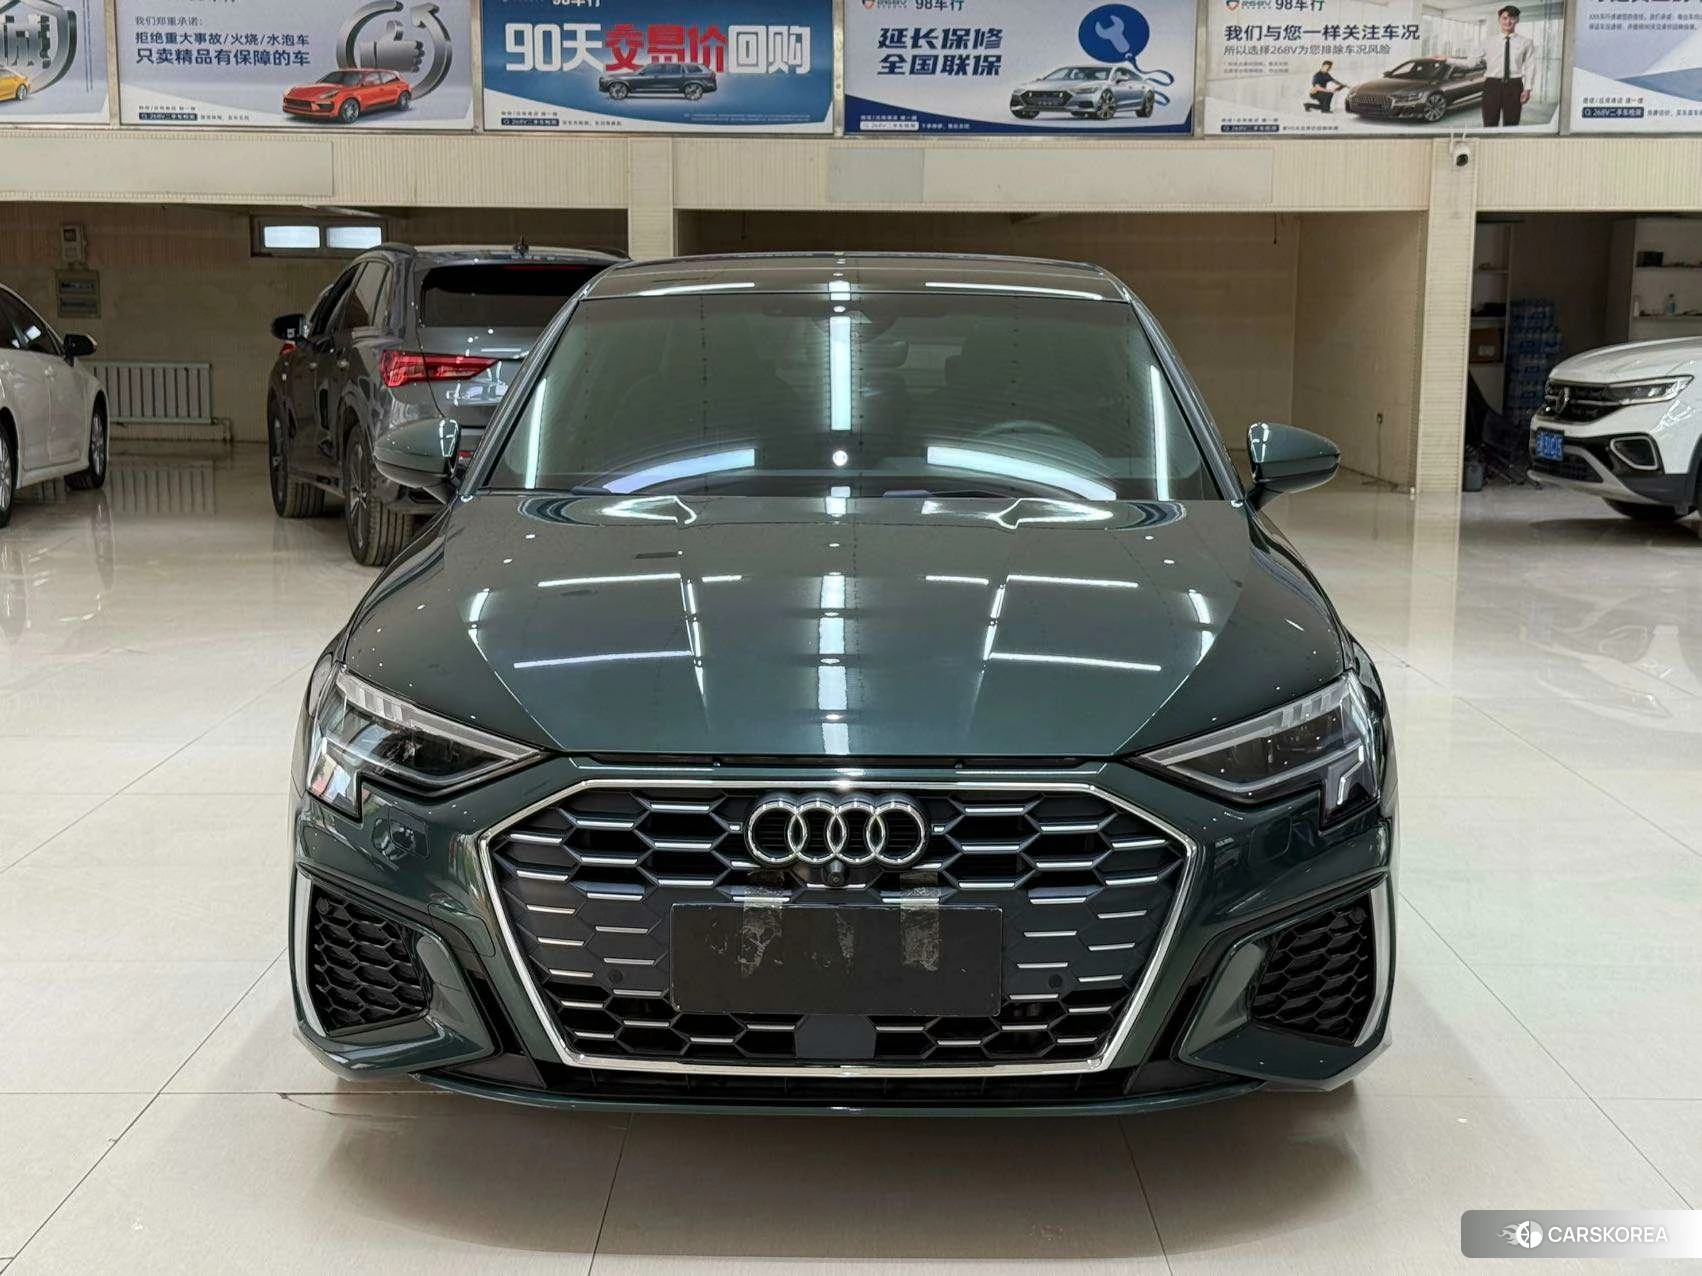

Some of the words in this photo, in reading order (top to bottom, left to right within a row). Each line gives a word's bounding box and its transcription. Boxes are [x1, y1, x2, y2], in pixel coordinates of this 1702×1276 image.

[135, 32, 310, 46] 拒绝重大事故/火烧/水泡车
[877, 27, 1004, 50] 延长保修
[1224, 24, 1420, 41] 我们与您一样关注车况
[135, 48, 311, 66] 只卖精品有保障的车
[504, 23, 812, 75] 90天交易价回购
[1223, 44, 1391, 56] 所以选择268V为您排除车况风险
[877, 53, 1003, 76] 全国联保
